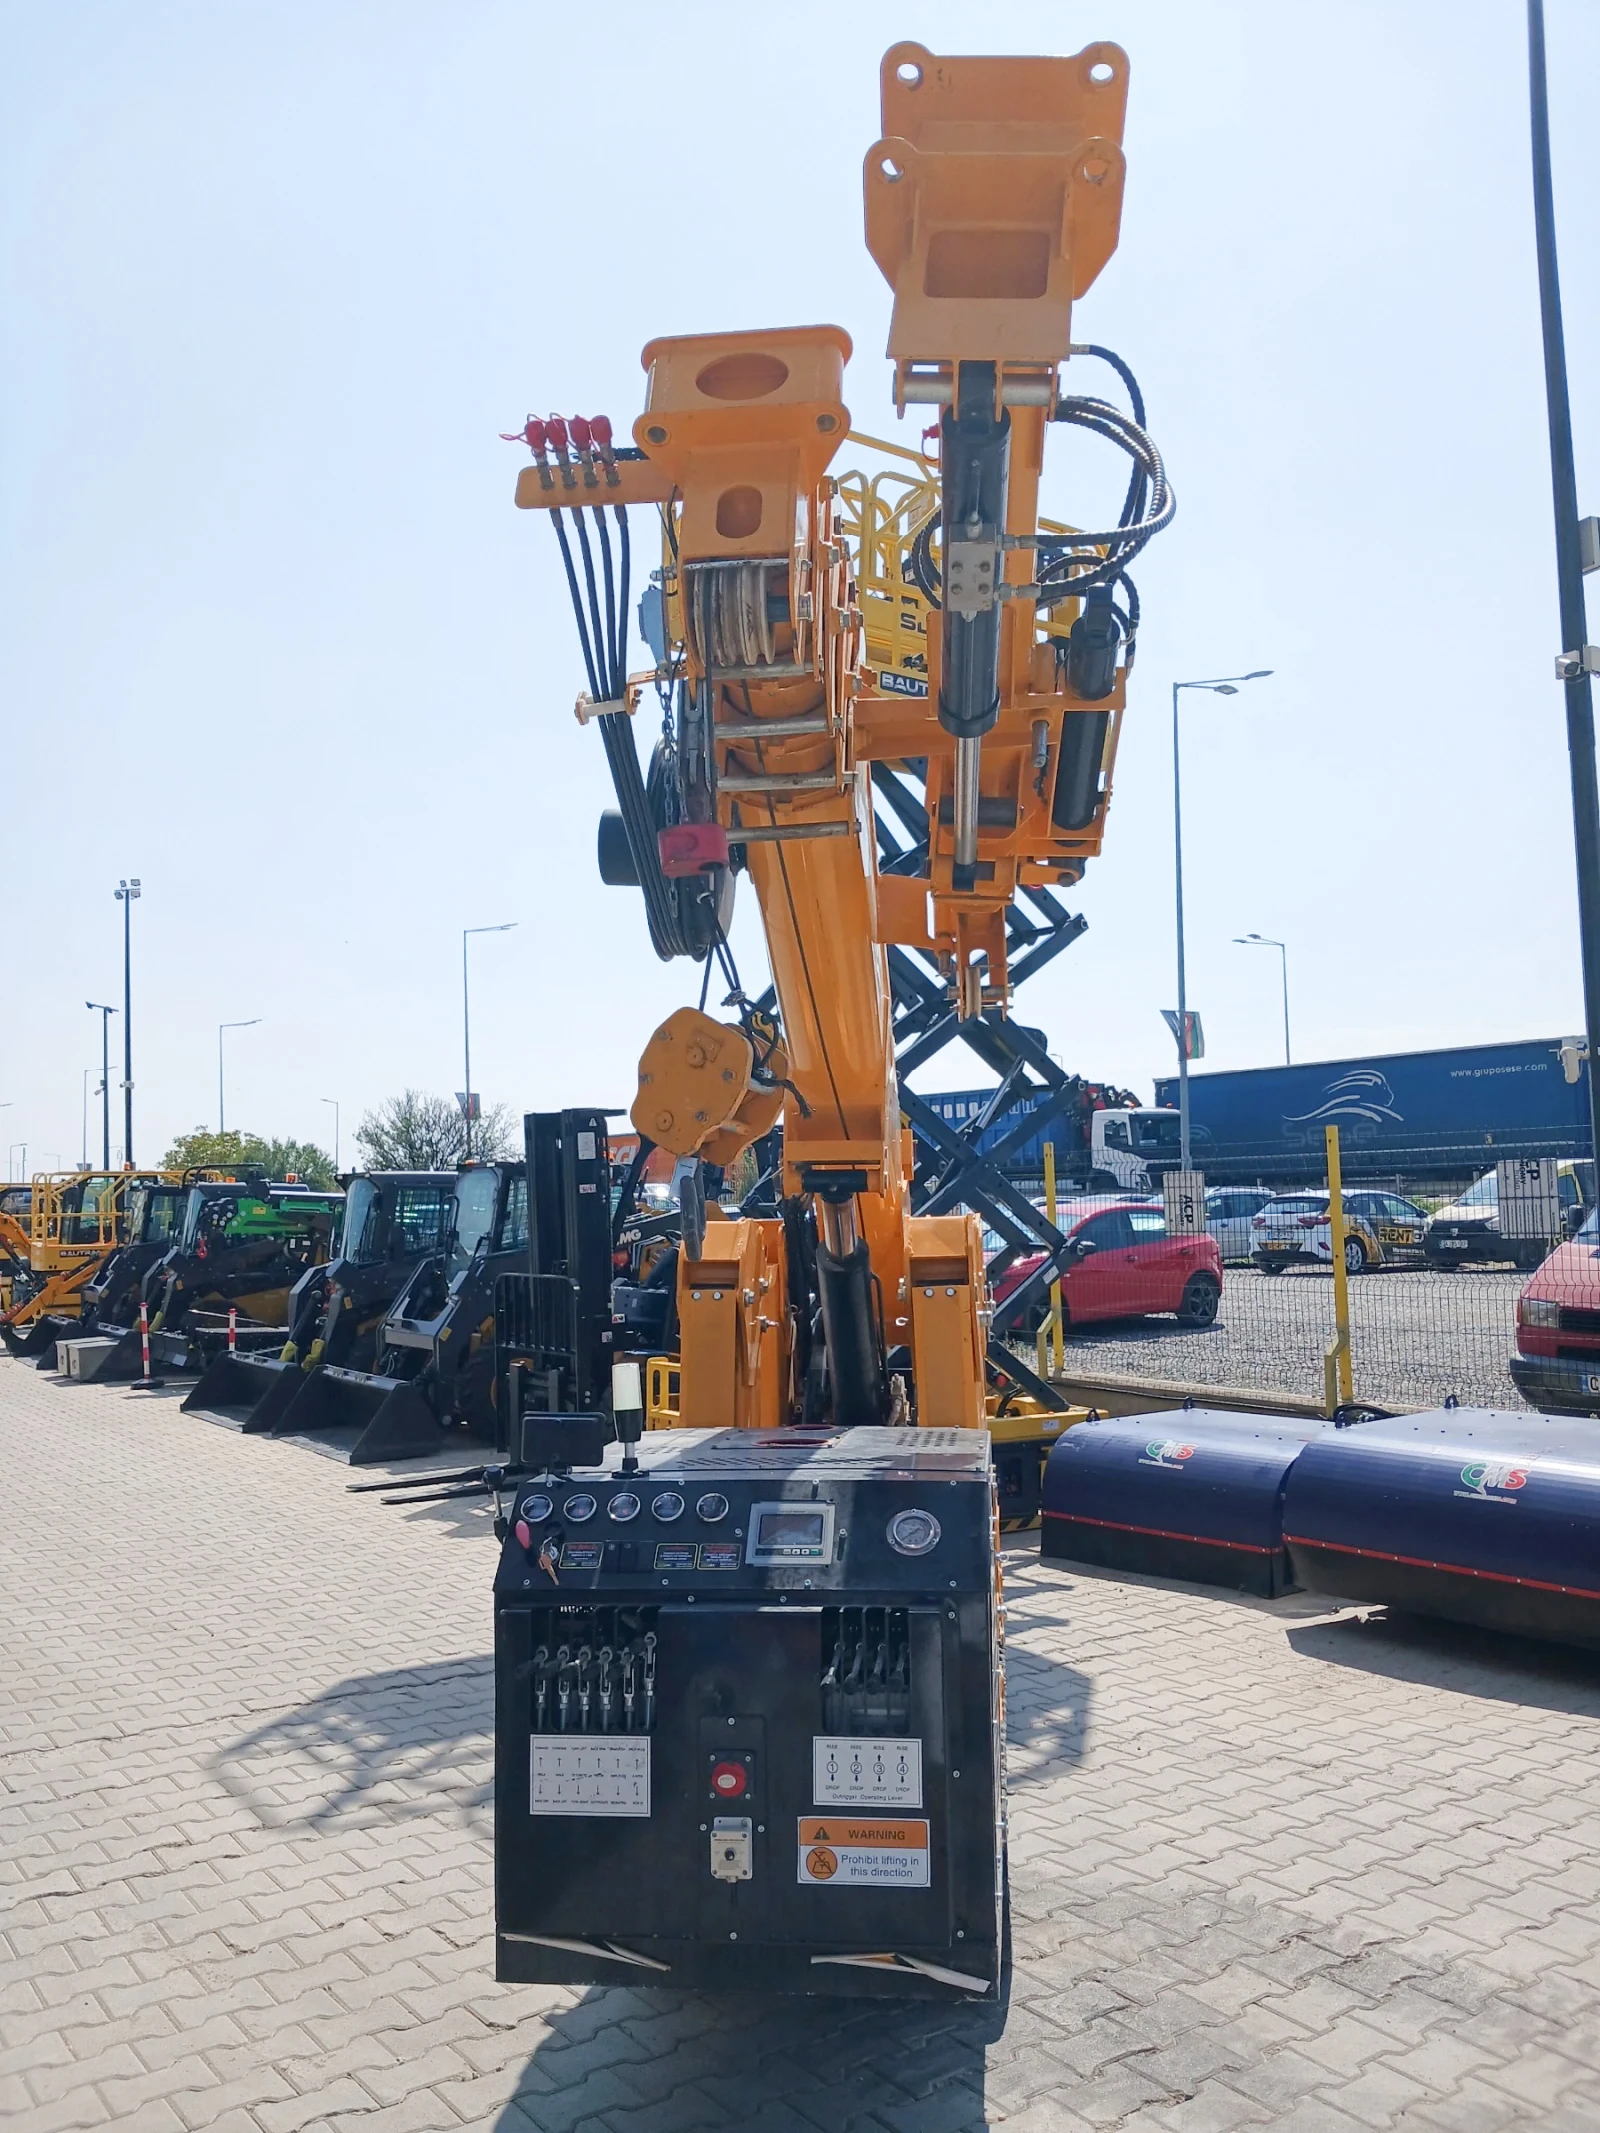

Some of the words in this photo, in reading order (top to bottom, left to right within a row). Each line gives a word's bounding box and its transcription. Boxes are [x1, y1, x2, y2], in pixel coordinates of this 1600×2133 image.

[1183, 1195, 1194, 1224] ACP
[848, 1829, 905, 1840] WARNING
[841, 1854, 878, 1864] Prohibit
[881, 1855, 907, 1867] lifting
[911, 1856, 919, 1866] in
[851, 1867, 868, 1876] this
[870, 1868, 913, 1877] direction
